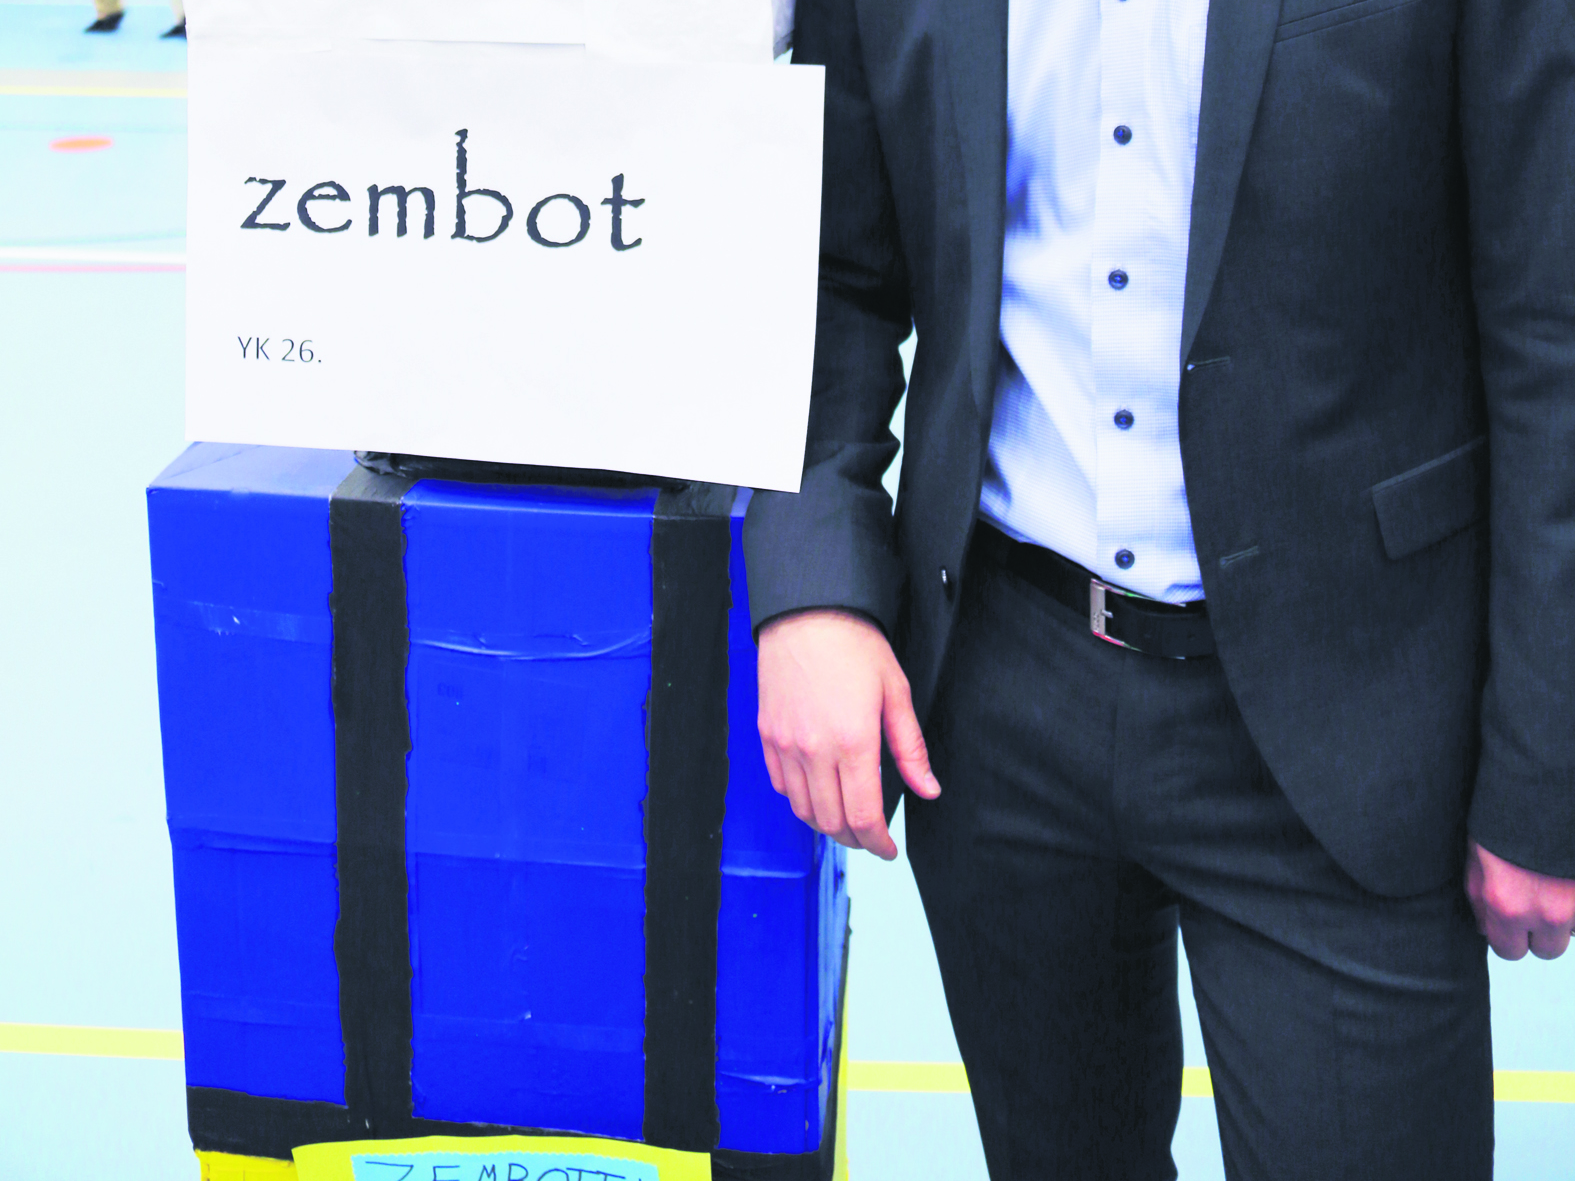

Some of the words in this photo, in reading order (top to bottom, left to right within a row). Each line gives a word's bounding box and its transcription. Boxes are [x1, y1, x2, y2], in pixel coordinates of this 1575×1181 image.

[241, 128, 645, 251] zembot
[237, 336, 270, 360] YK
[281, 338, 322, 363] 26.
